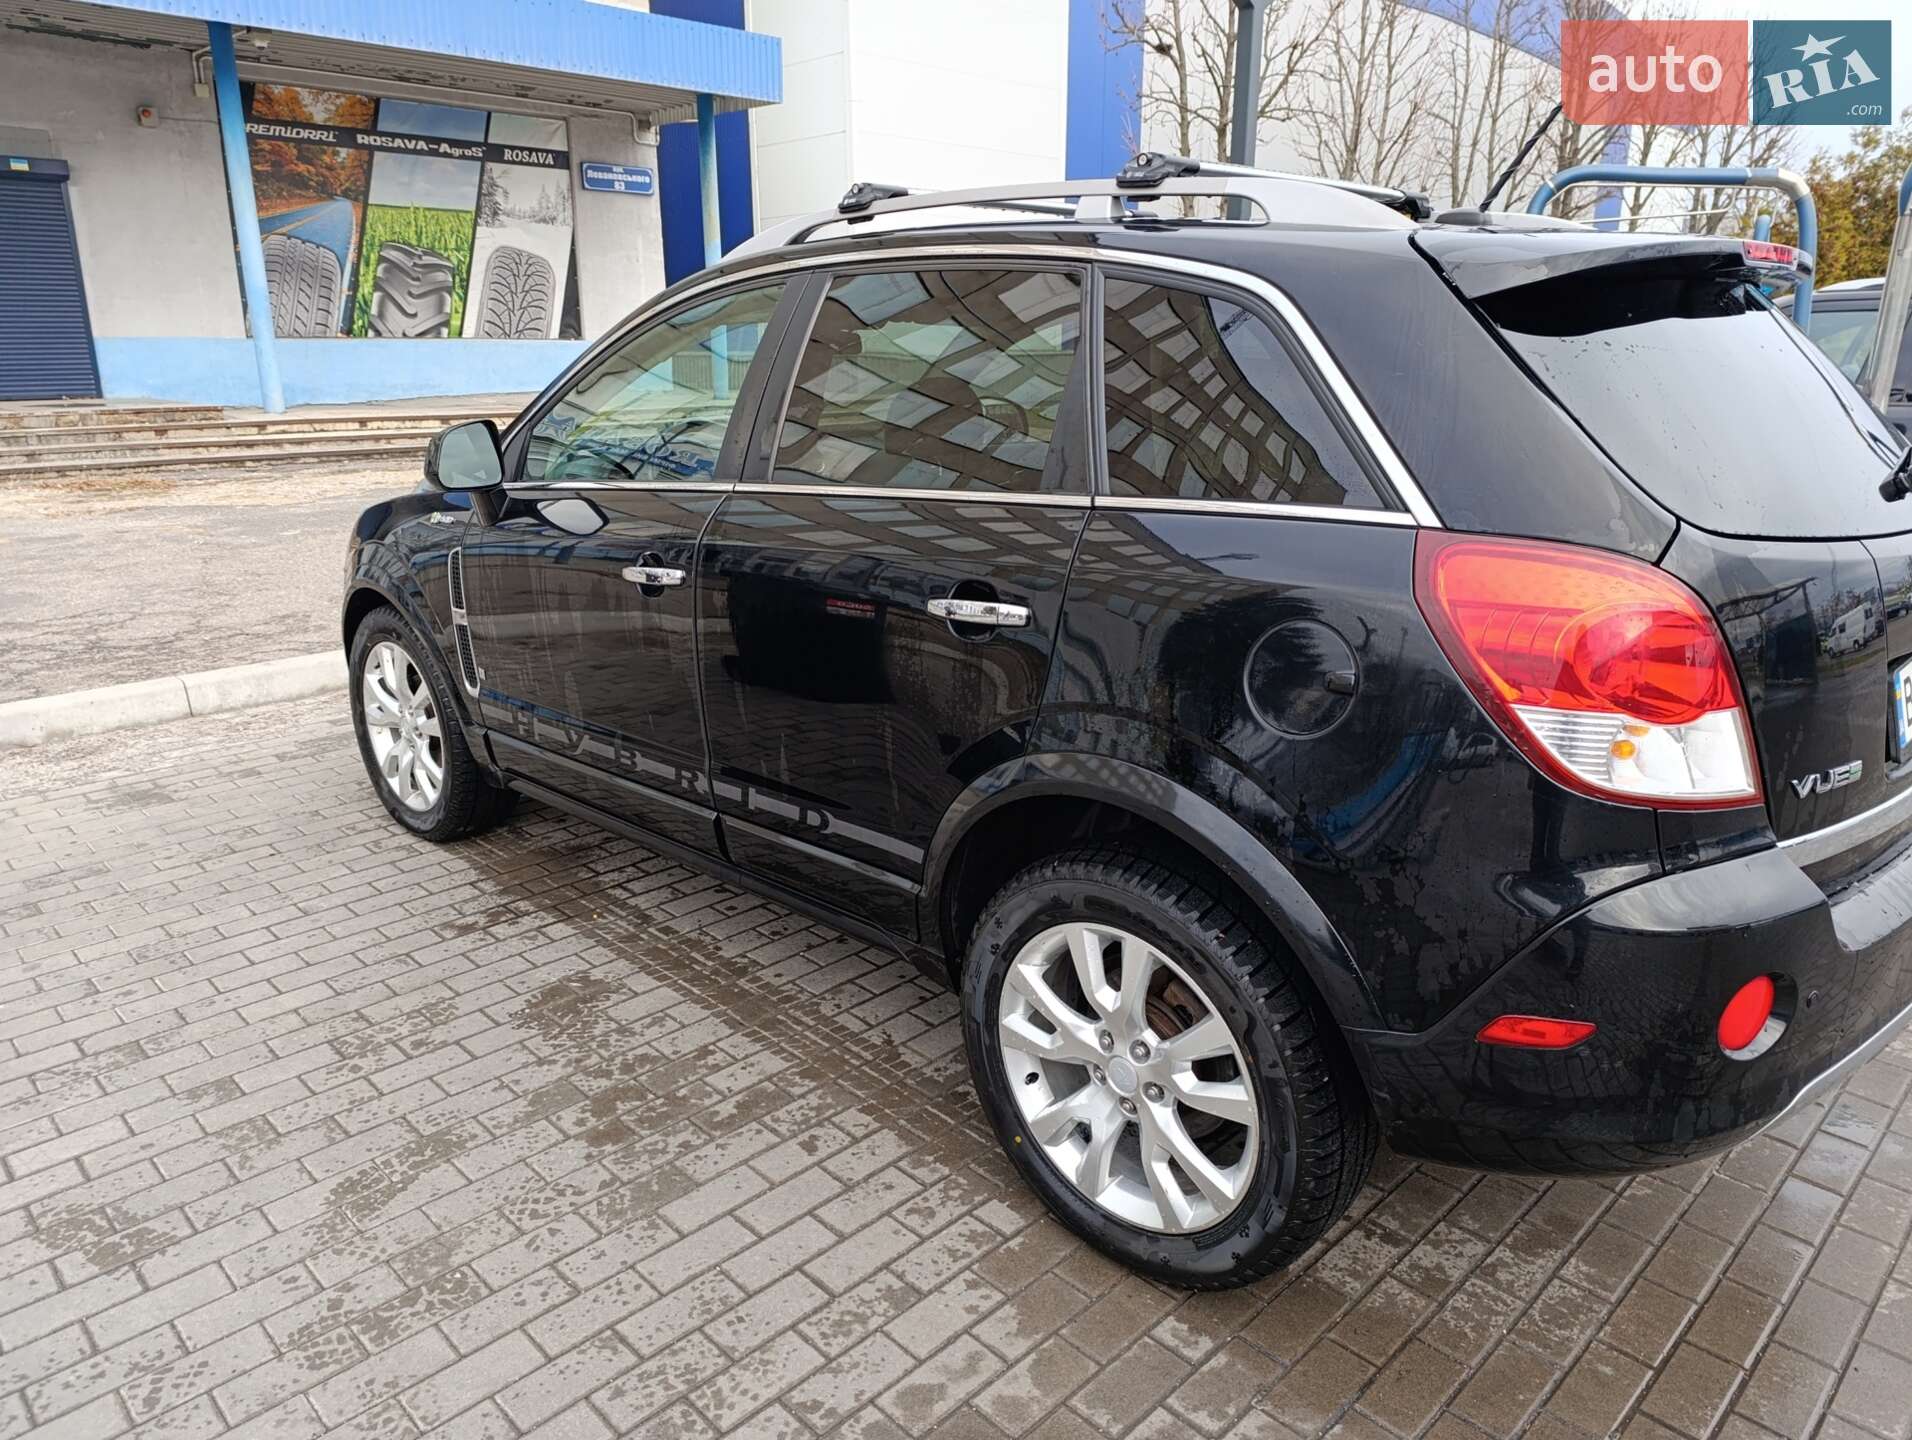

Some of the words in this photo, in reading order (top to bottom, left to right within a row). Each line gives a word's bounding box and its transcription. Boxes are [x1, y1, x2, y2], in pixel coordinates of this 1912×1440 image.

[245, 122, 337, 143] REMIORRI
[503, 148, 555, 166] ROSAVA
[1791, 760, 1863, 799] VUE
